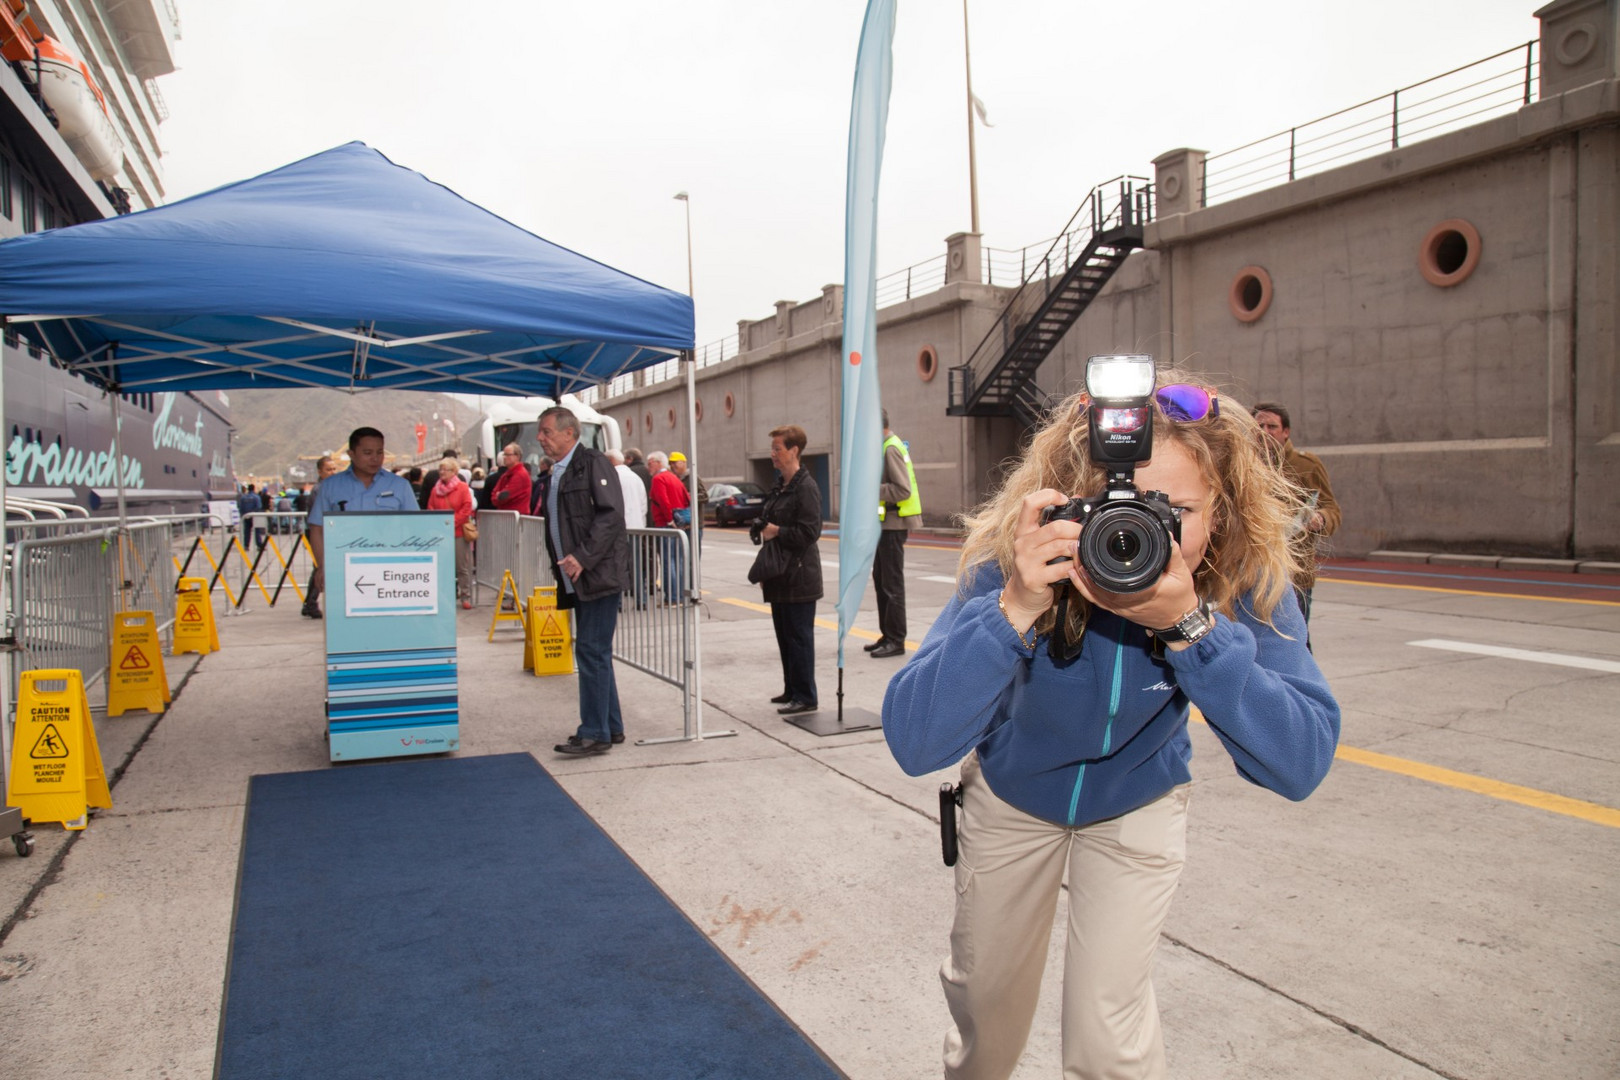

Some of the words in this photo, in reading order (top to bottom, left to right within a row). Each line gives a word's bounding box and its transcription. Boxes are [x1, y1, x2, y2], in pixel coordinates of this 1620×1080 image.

[1108, 491, 1135, 499] Nikon
[336, 536, 386, 549] Mein
[383, 570, 430, 583] Eingang
[377, 588, 430, 599] Entrance
[31, 706, 70, 715] CAUTION
[31, 714, 70, 723] ATTENTION
